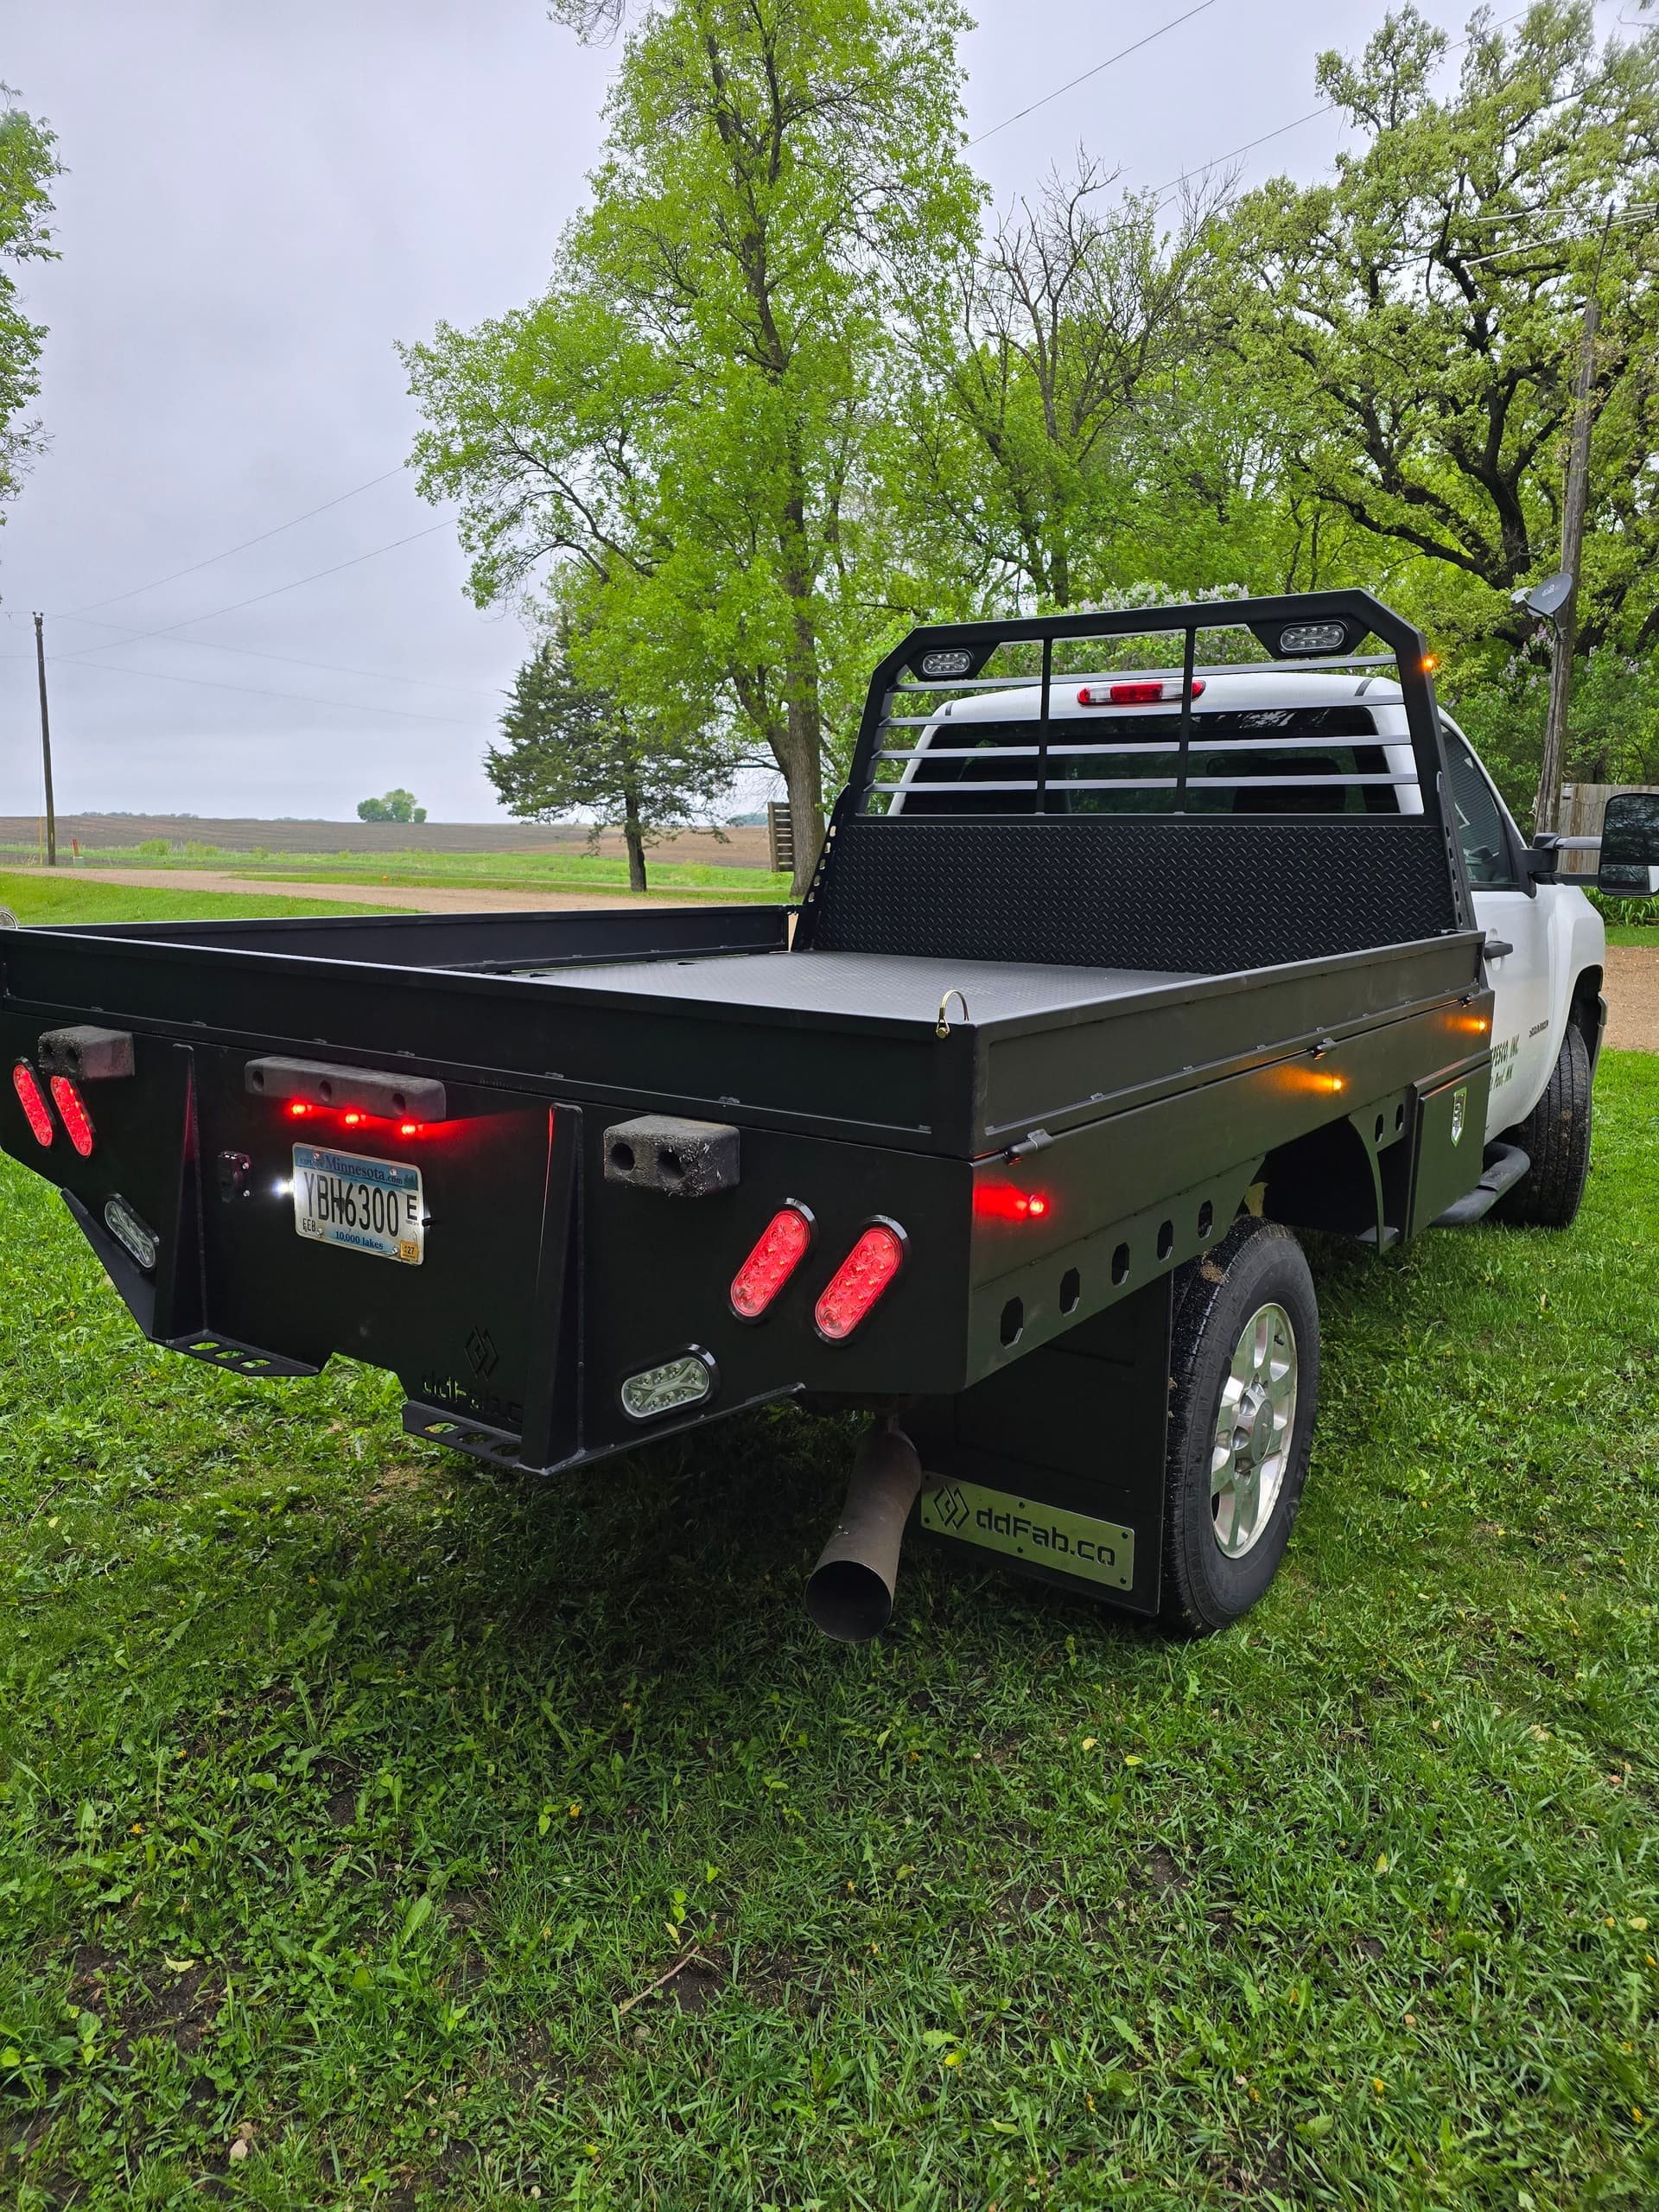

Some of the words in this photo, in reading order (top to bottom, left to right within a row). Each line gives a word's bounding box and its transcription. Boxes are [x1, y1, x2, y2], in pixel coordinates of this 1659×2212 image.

[406, 1193, 418, 1220] E
[335, 1230, 360, 1245] 10,000
[362, 1236, 384, 1250] lakes
[407, 1246, 415, 1255] 27
[976, 1507, 1116, 1567] ddFab.co
